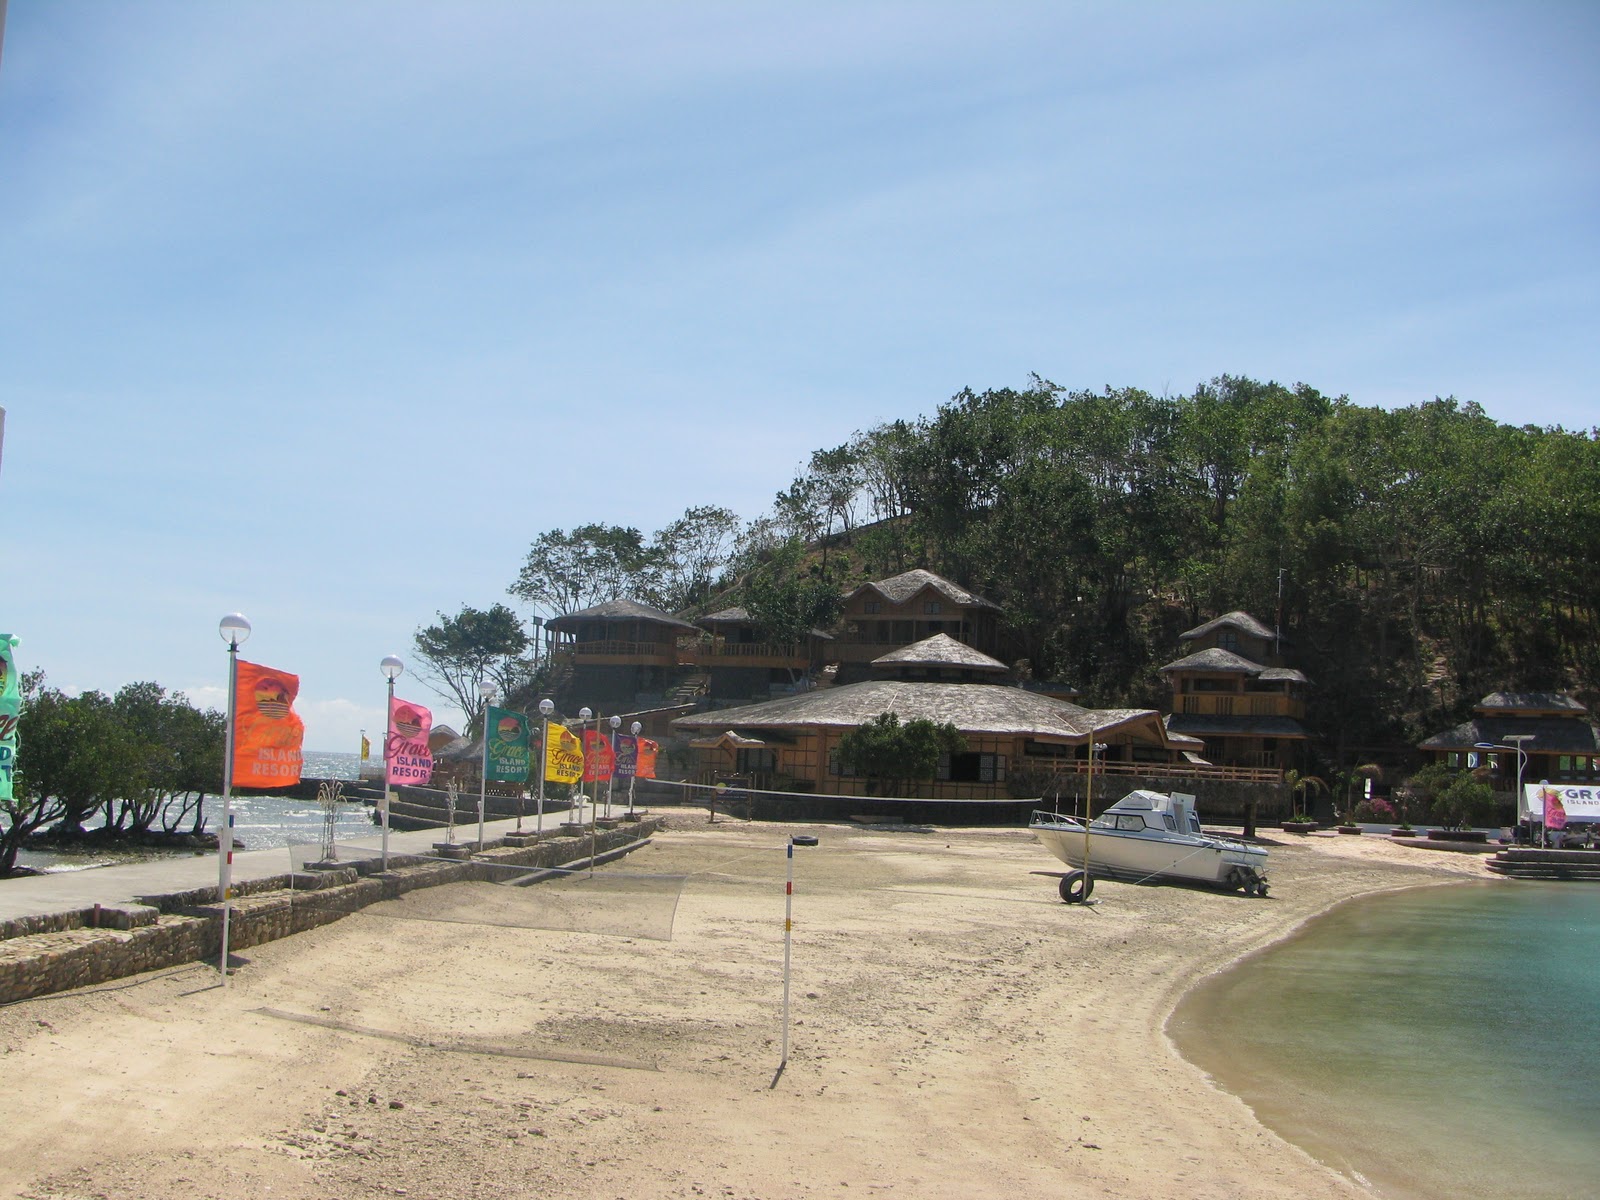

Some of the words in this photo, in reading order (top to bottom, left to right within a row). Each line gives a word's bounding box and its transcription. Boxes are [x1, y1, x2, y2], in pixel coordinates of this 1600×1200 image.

[397, 756, 432, 768] ISLAND
[500, 757, 526, 766] ISLAND
[552, 748, 583, 765] Grace
[252, 762, 300, 777] RESOR
[392, 767, 431, 778] RESOR
[496, 765, 528, 773] RESORT
